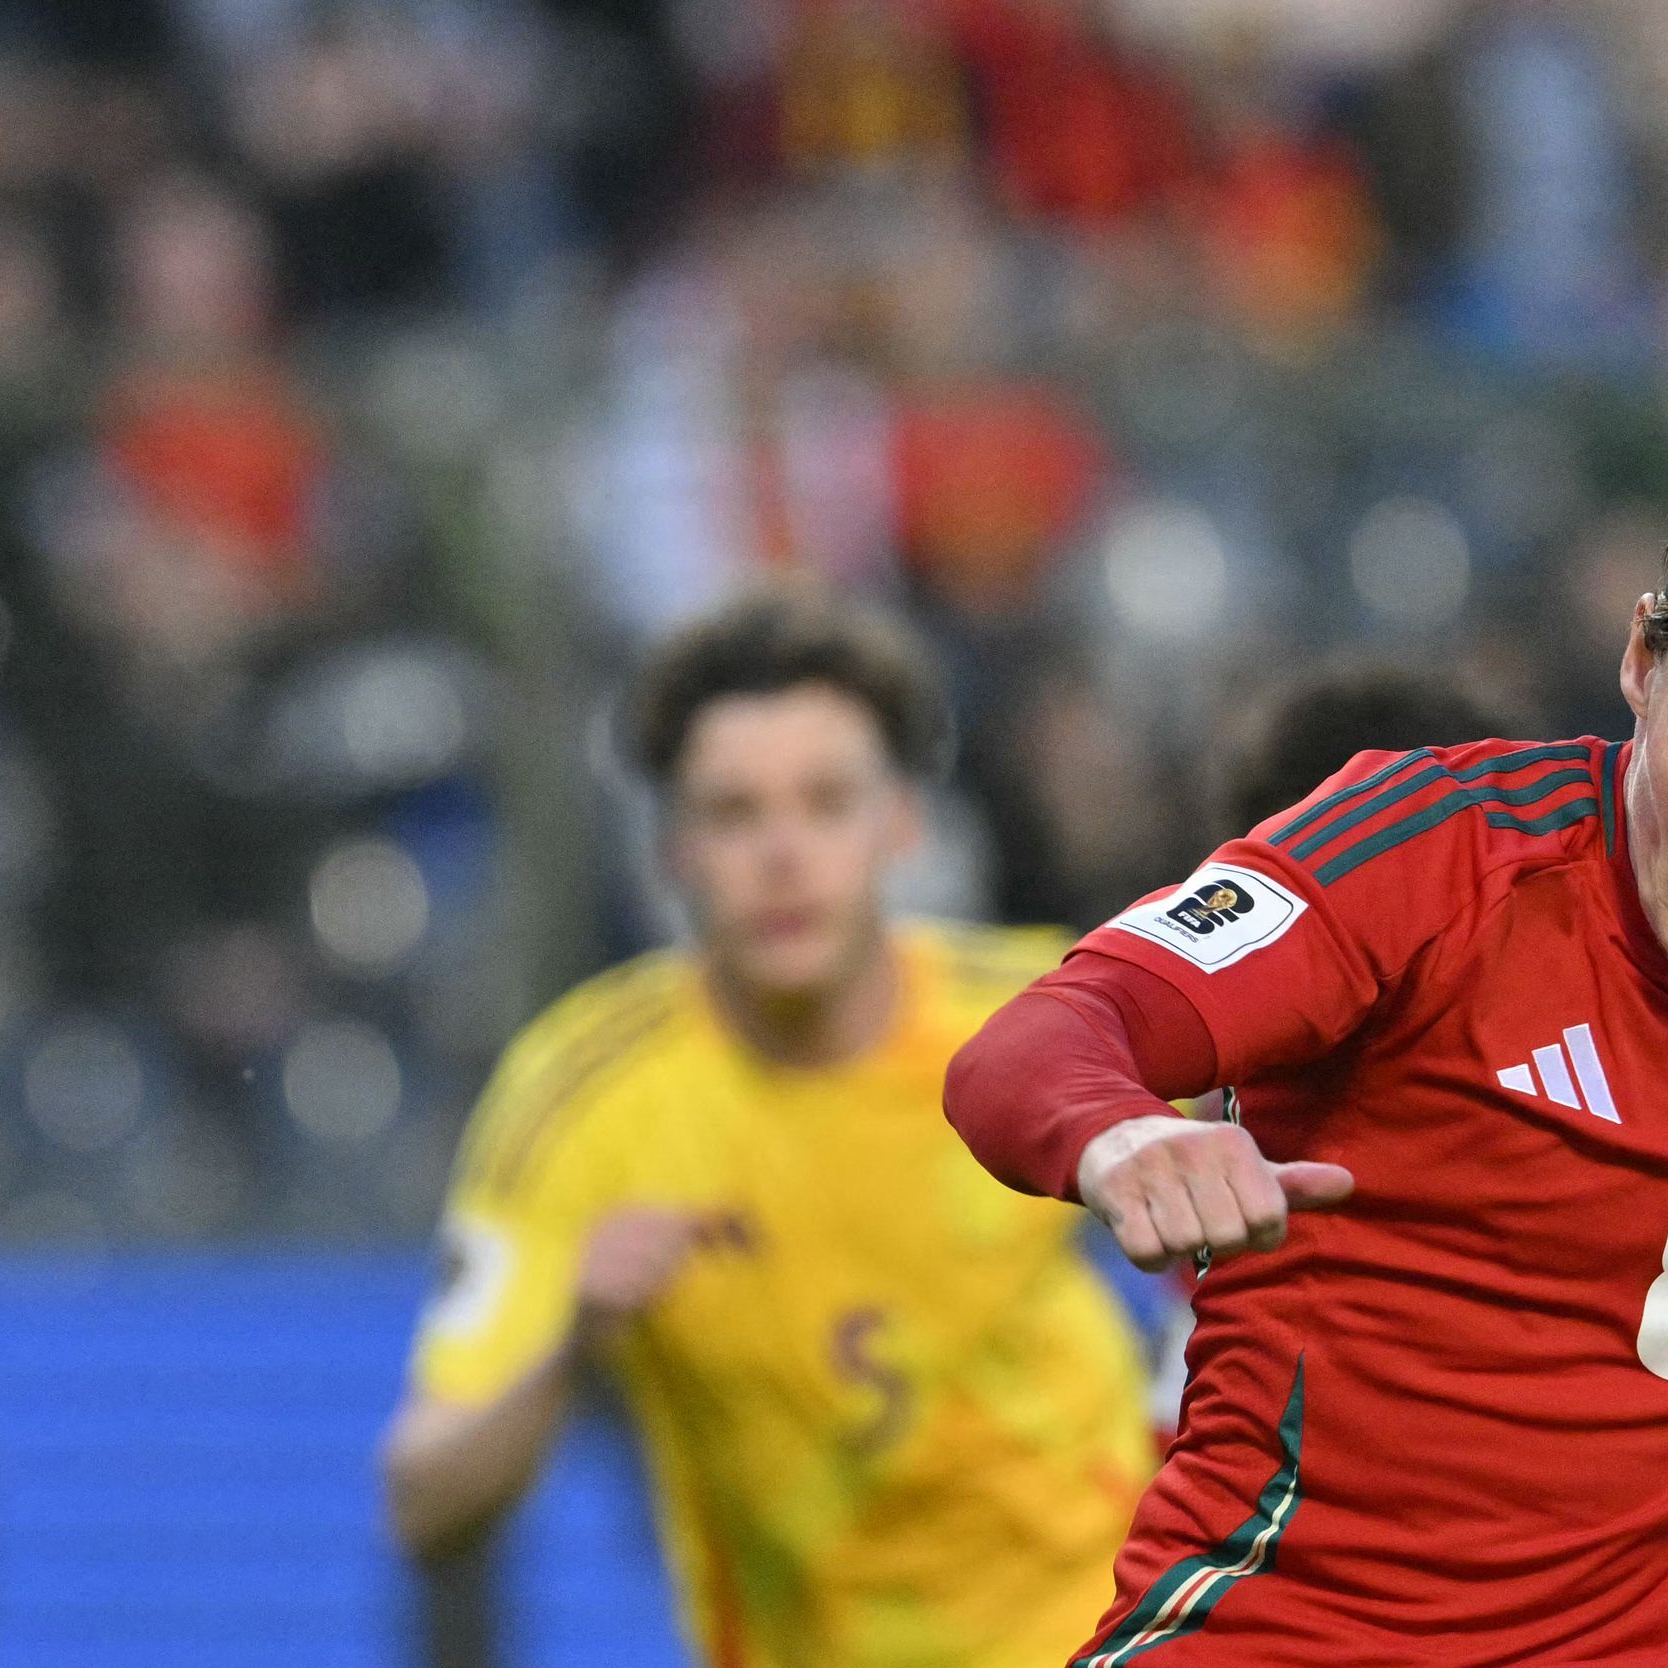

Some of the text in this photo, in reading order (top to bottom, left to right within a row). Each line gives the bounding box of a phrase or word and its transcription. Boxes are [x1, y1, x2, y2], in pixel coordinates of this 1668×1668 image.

[1153, 916, 1200, 943] QUALIFIERS
[1177, 911, 1202, 928] FIFA
[828, 1300, 914, 1453] 5
